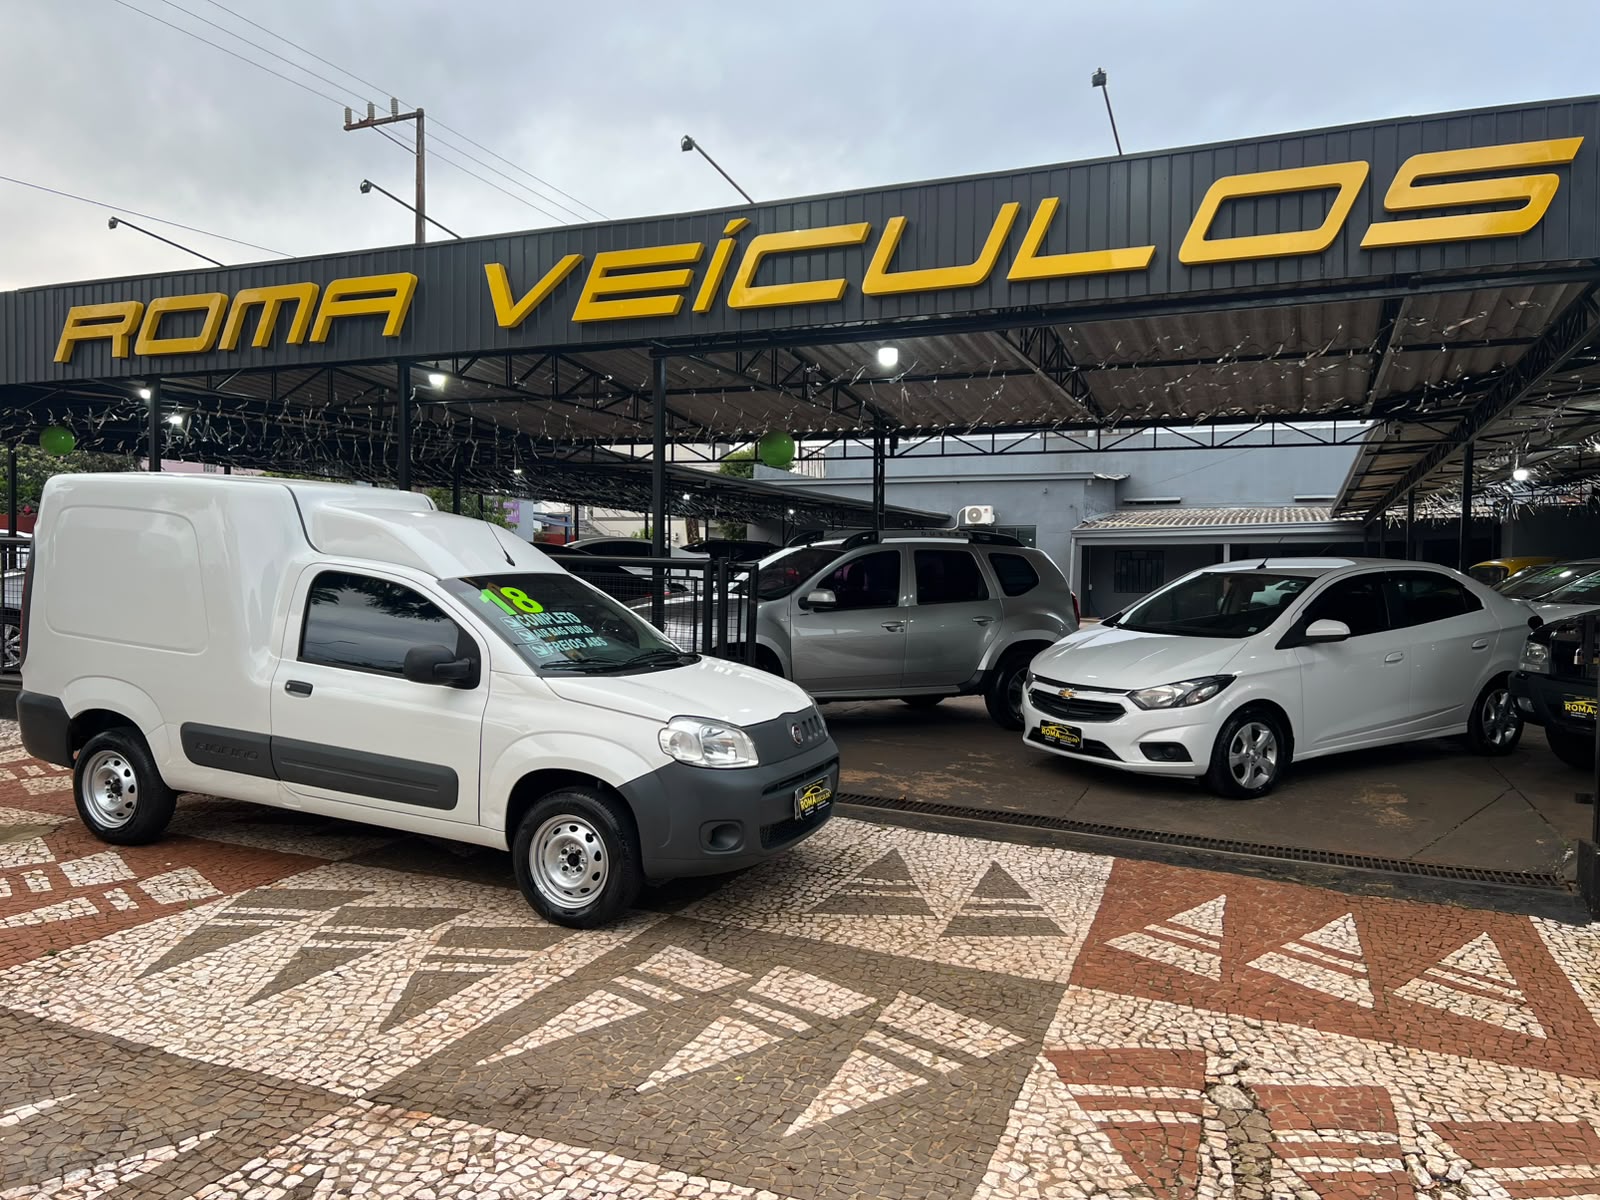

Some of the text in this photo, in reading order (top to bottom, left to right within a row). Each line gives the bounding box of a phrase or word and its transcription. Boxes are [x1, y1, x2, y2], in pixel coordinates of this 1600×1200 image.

[54, 137, 1585, 363] ROMA VEÍCULOS
[479, 586, 544, 616] 18
[515, 611, 582, 628] COMPLETO
[532, 625, 594, 639] AIR BAG DUPLO
[544, 636, 608, 654] FREIOS ABS
[1563, 703, 1594, 715] ROMA
[1041, 727, 1060, 738] ROMA
[800, 794, 817, 811] ROMA
